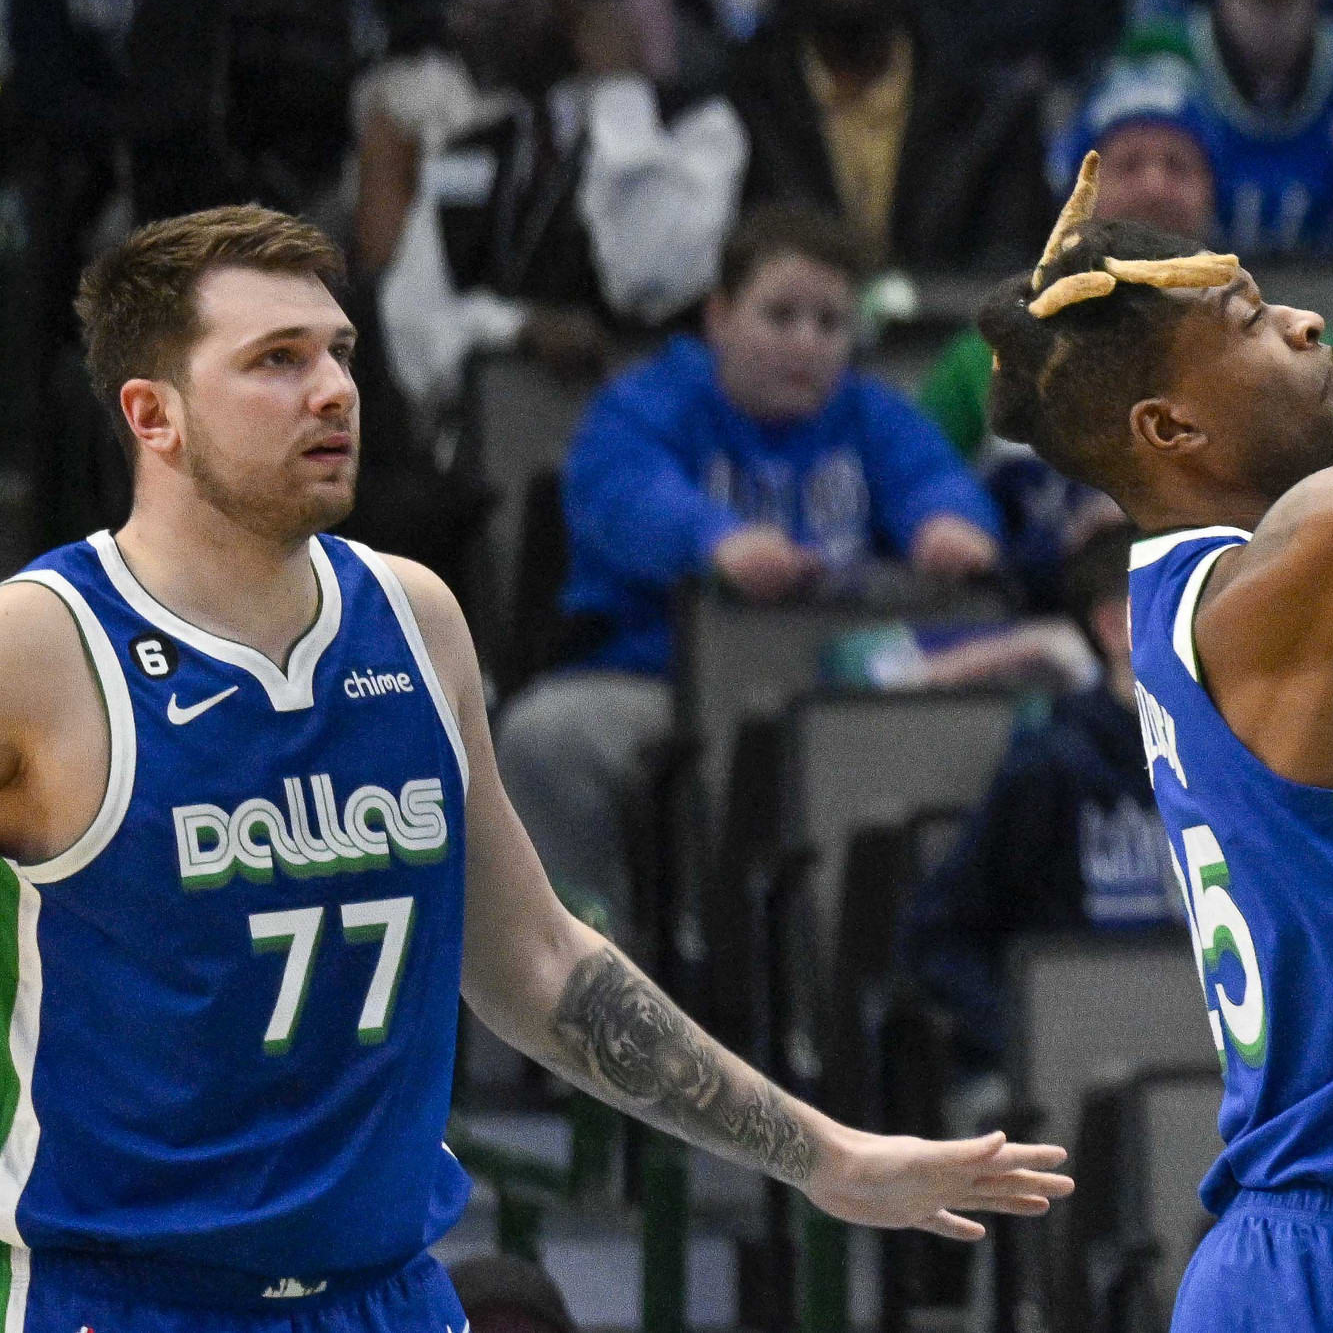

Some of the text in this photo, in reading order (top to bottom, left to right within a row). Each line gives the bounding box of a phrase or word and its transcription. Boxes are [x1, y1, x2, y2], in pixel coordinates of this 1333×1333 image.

[137, 639, 169, 676] 6
[343, 670, 415, 699] chime
[248, 896, 415, 1054] 77
